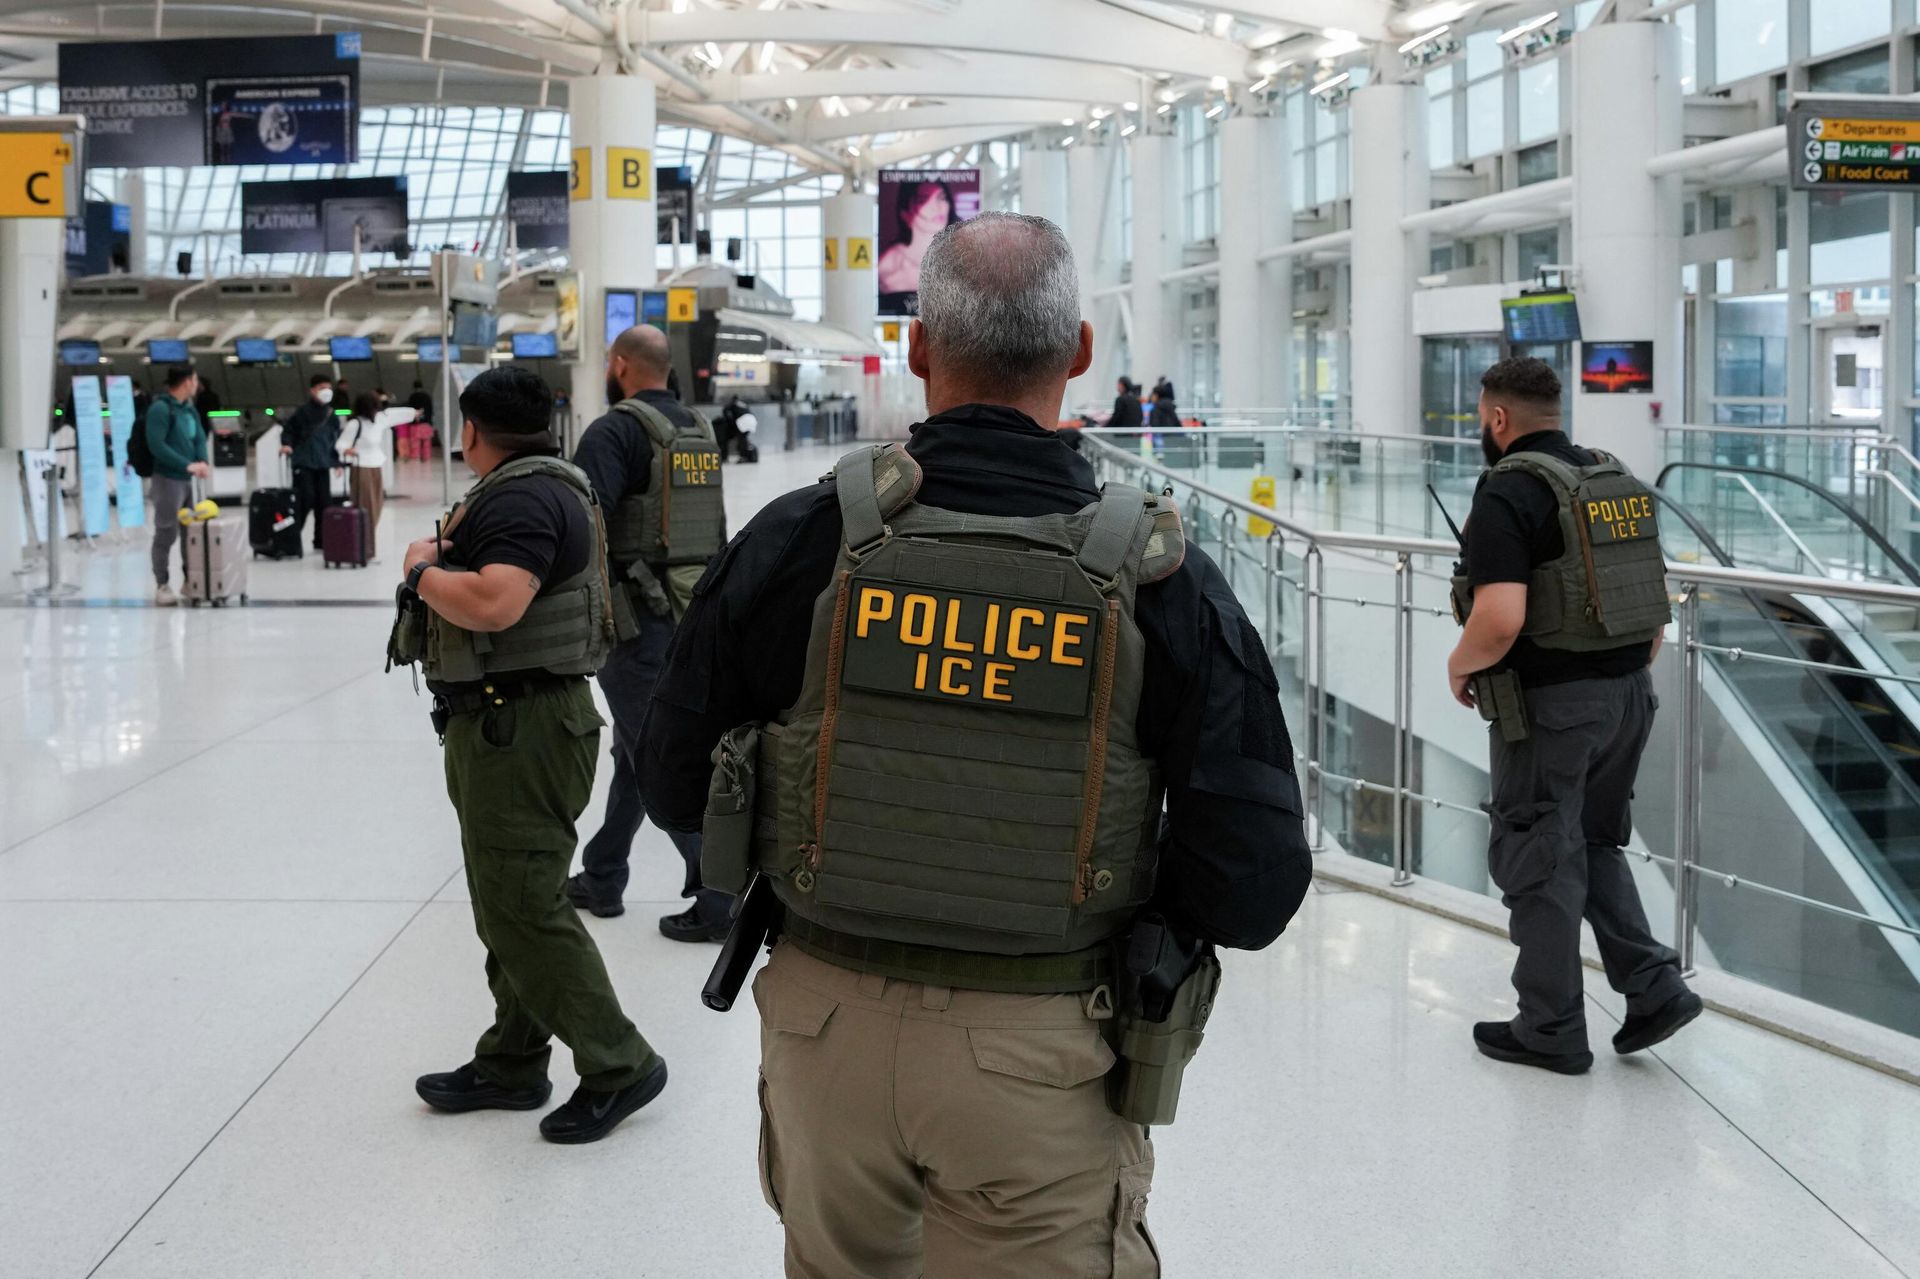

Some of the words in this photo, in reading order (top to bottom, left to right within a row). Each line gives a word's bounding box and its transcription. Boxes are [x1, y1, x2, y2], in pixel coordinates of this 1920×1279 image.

[62, 86, 129, 100] EXCLUSIVE
[131, 85, 177, 99] ACCESS
[179, 83, 197, 99] TO
[1843, 123, 1906, 136] Departures
[1842, 144, 1889, 158] AirTrain
[623, 158, 641, 188] B
[1840, 165, 1873, 179] Food
[1874, 166, 1909, 180] Court
[26, 171, 50, 205] C
[246, 213, 317, 230] PLATINUM
[854, 244, 870, 262] A
[673, 453, 720, 470] POLICE
[687, 471, 707, 484] ICE
[1587, 496, 1652, 524] POLICE
[1611, 522, 1639, 539] ICE
[856, 587, 1089, 667] POLICE
[914, 652, 1016, 702] ICE
